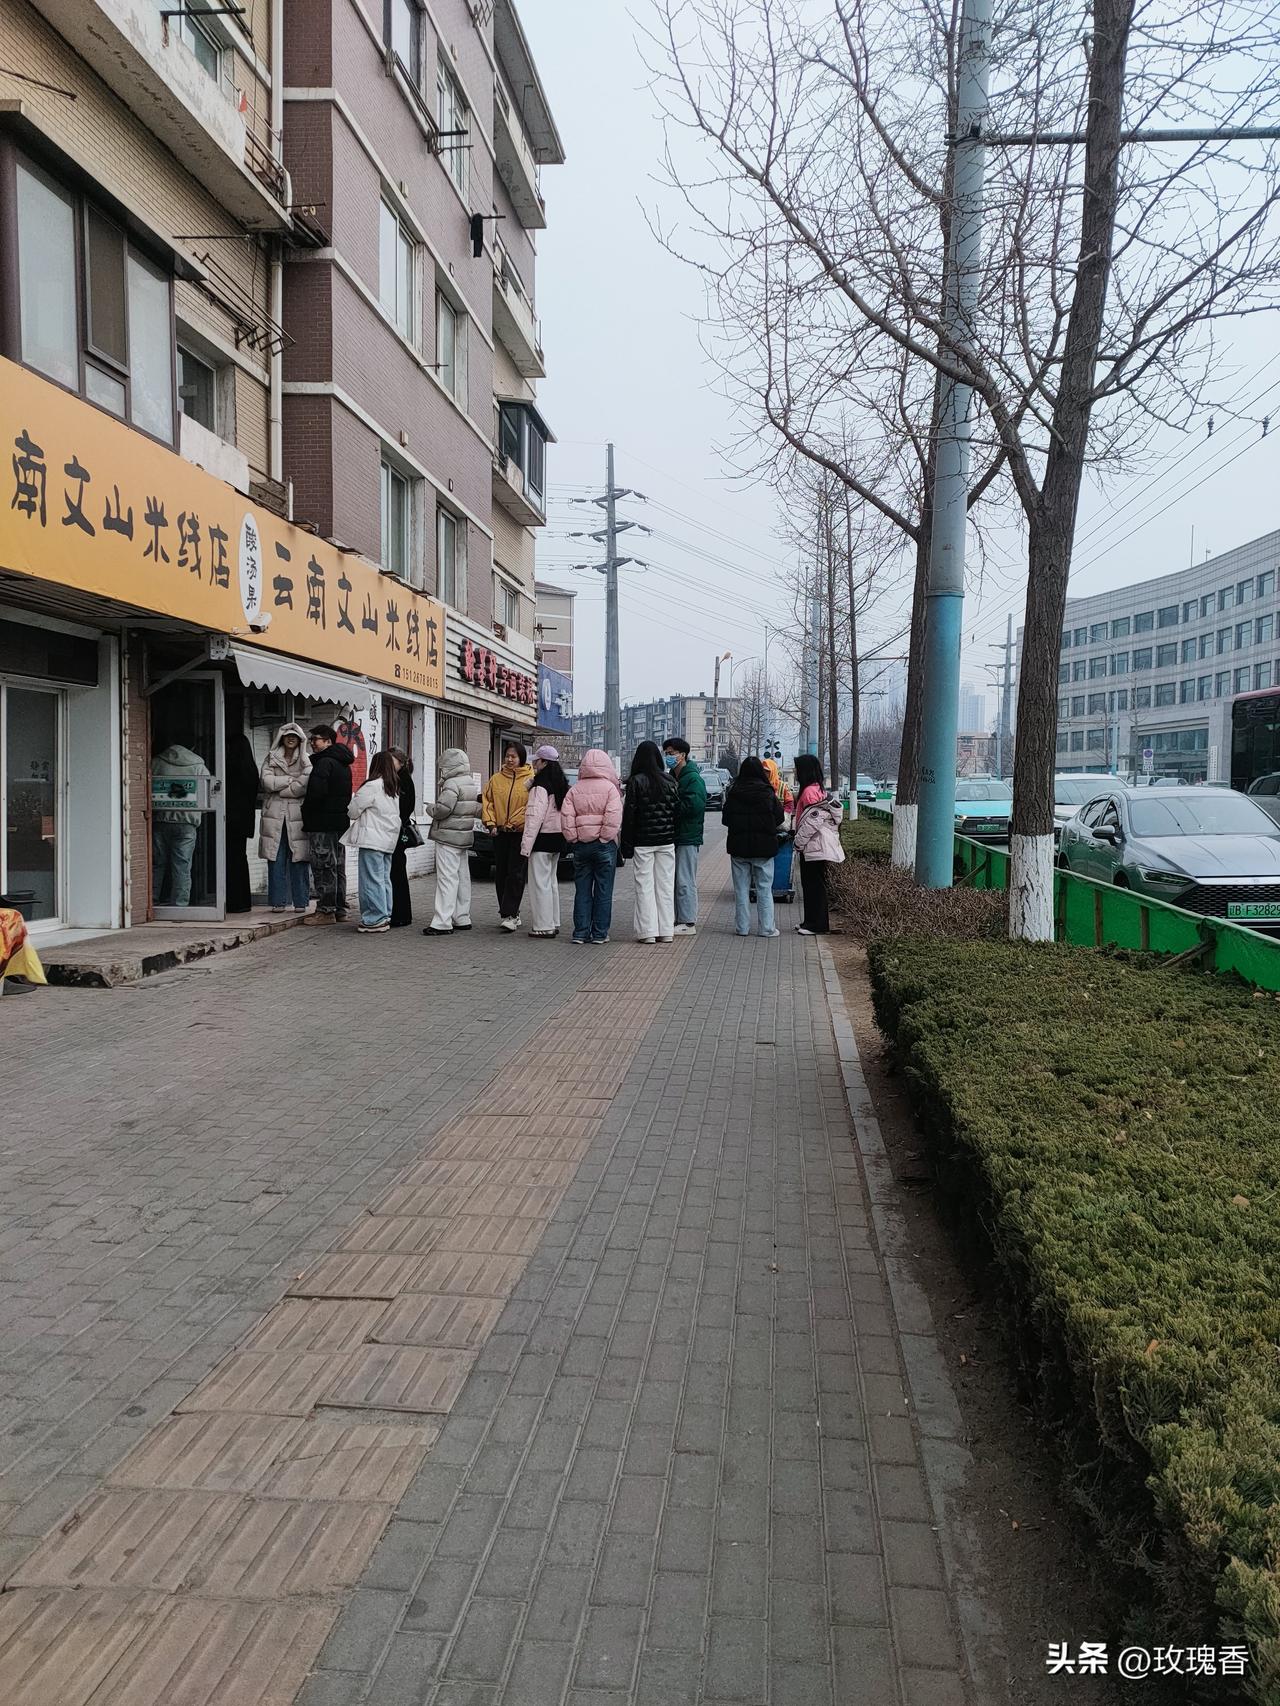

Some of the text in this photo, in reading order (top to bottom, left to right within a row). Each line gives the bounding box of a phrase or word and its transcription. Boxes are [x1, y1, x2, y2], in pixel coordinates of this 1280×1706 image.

[272, 540, 438, 668] 云南文山米线店
